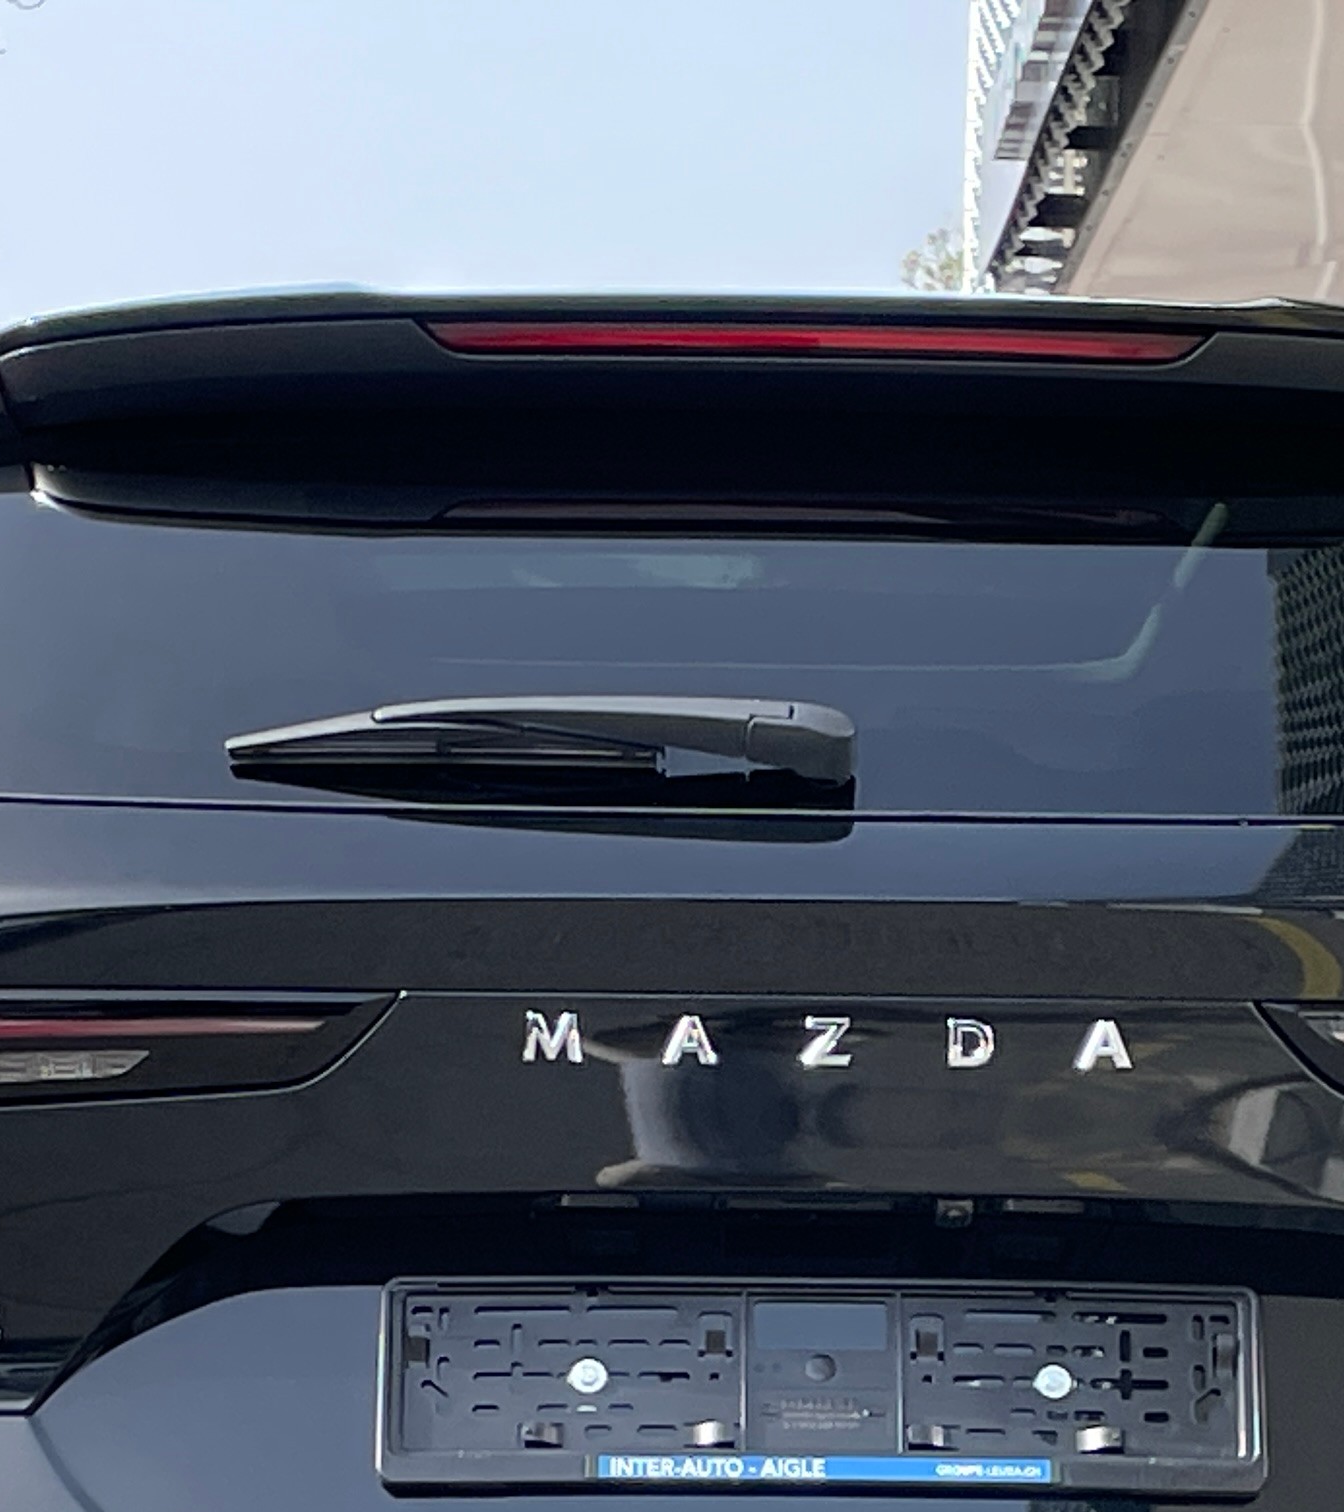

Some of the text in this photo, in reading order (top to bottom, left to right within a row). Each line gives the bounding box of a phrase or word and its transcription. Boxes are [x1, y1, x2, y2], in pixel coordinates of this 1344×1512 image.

[522, 1010, 1133, 1070] MAZDA
[609, 1457, 744, 1478] INTER-AUTO
[760, 1458, 826, 1479] AIGLE
